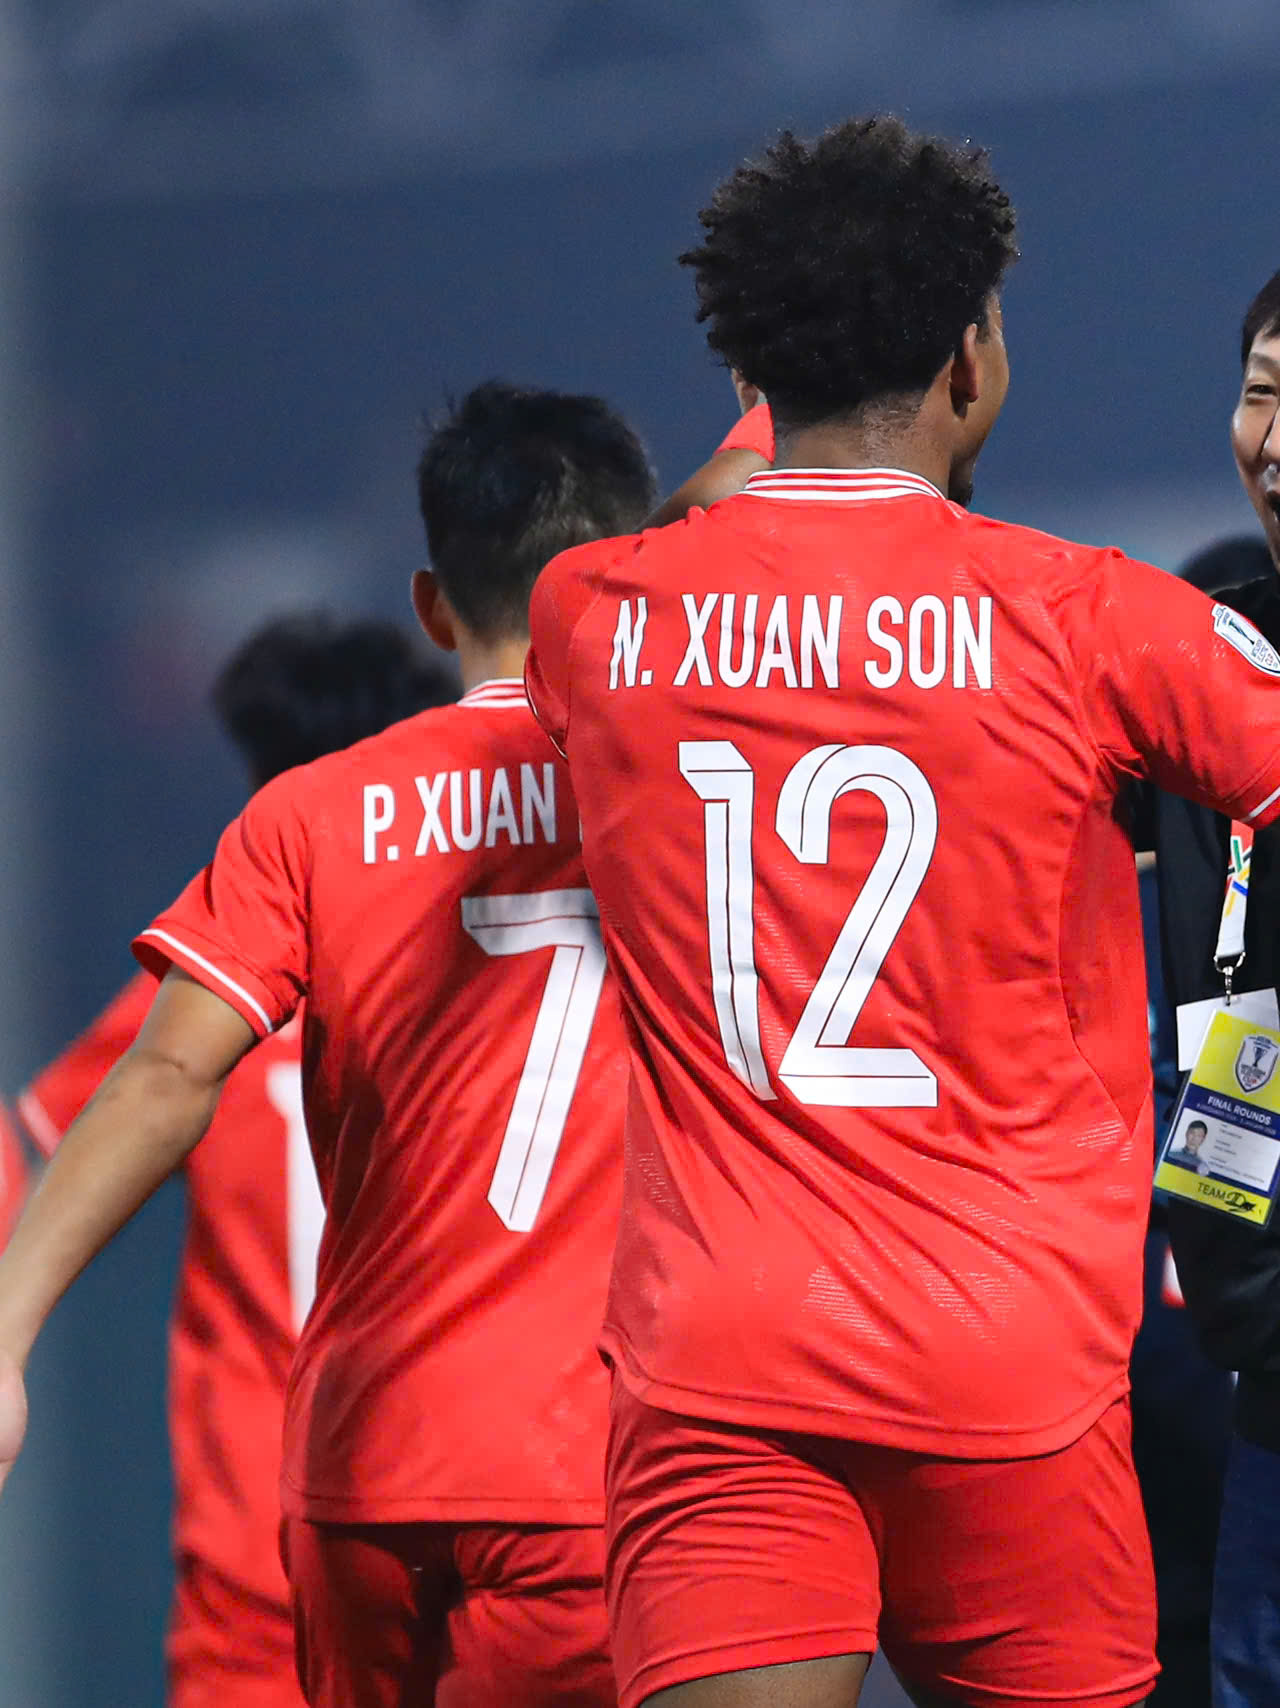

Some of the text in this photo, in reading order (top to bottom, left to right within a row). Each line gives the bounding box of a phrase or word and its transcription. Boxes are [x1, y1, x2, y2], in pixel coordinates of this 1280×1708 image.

[609, 593, 993, 690] N. XUAN SON
[363, 763, 556, 864] P. XUAN
[678, 740, 938, 1107] 12
[461, 888, 607, 1232] 7
[1207, 1095, 1233, 1113] FINAL
[1233, 1104, 1272, 1126] ROUNDS
[1197, 1182, 1226, 1201] TEAM
